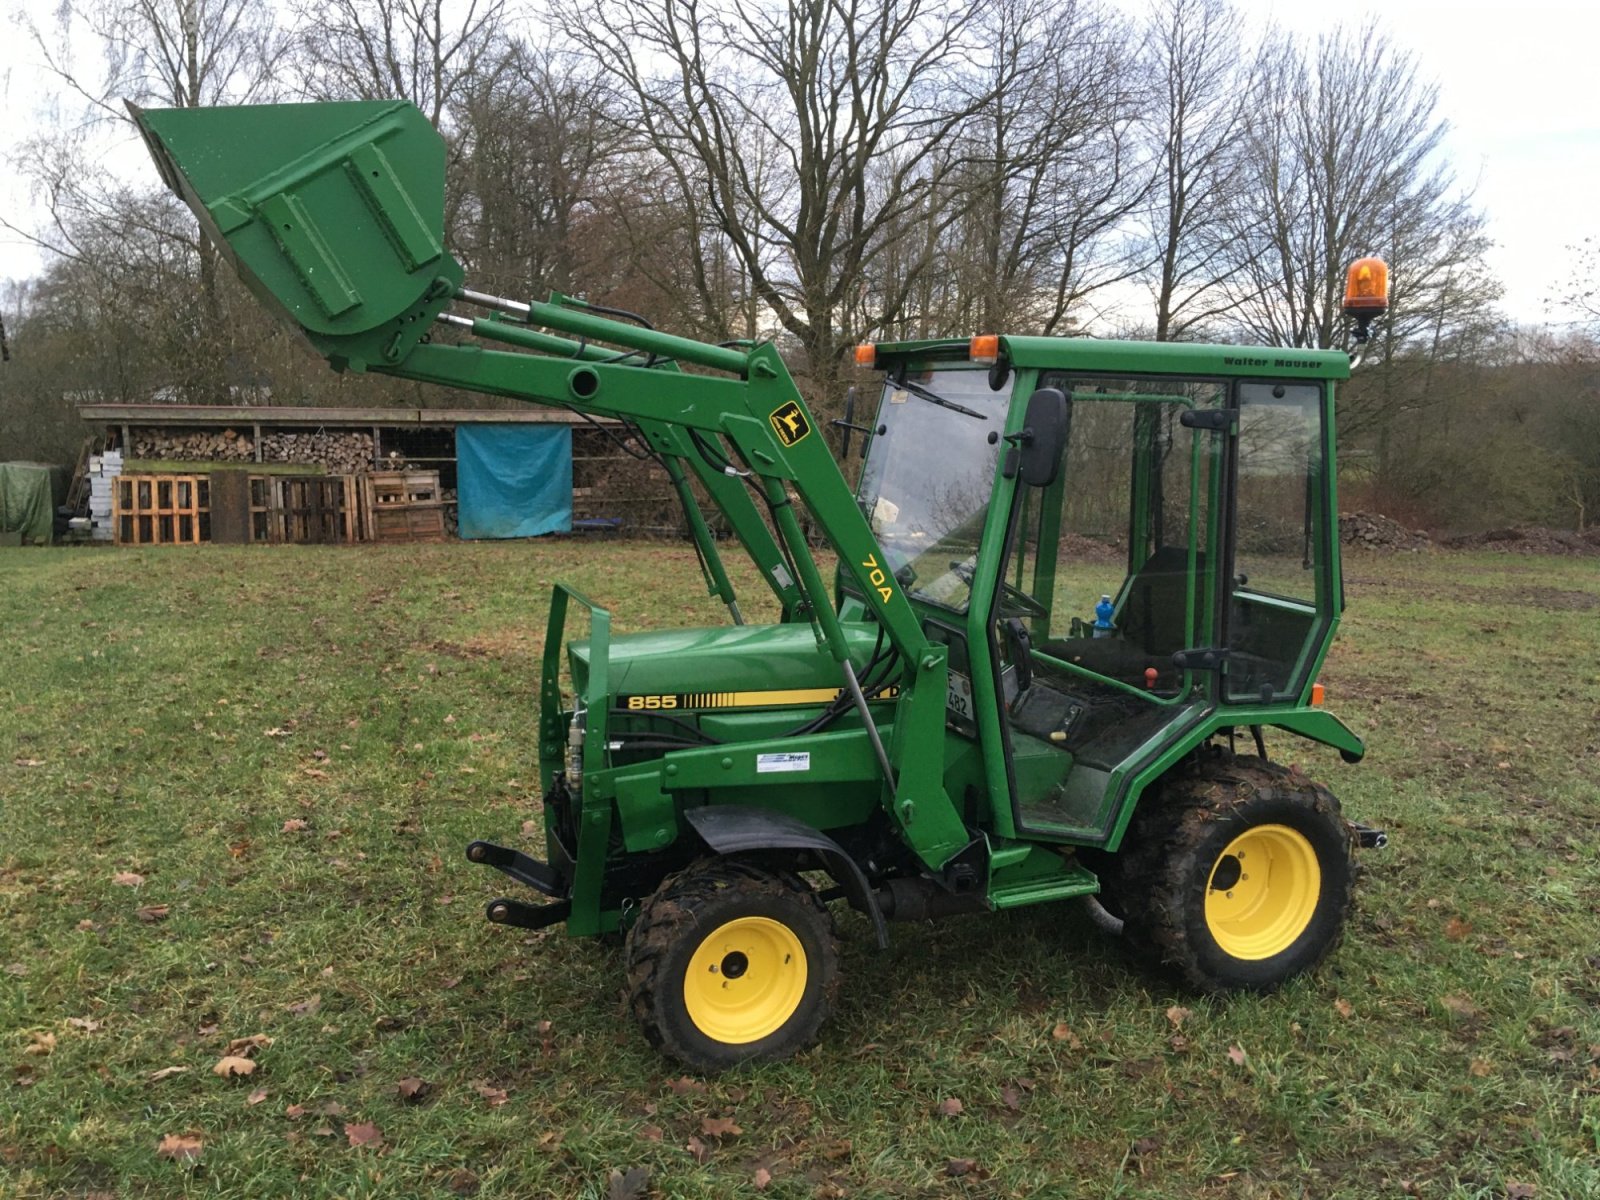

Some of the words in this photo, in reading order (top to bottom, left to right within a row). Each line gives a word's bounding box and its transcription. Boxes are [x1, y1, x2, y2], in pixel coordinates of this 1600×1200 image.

[1224, 357, 1268, 367] Walter
[1273, 359, 1322, 368] Mauser
[862, 553, 892, 603] 70A
[628, 695, 677, 710] 855
